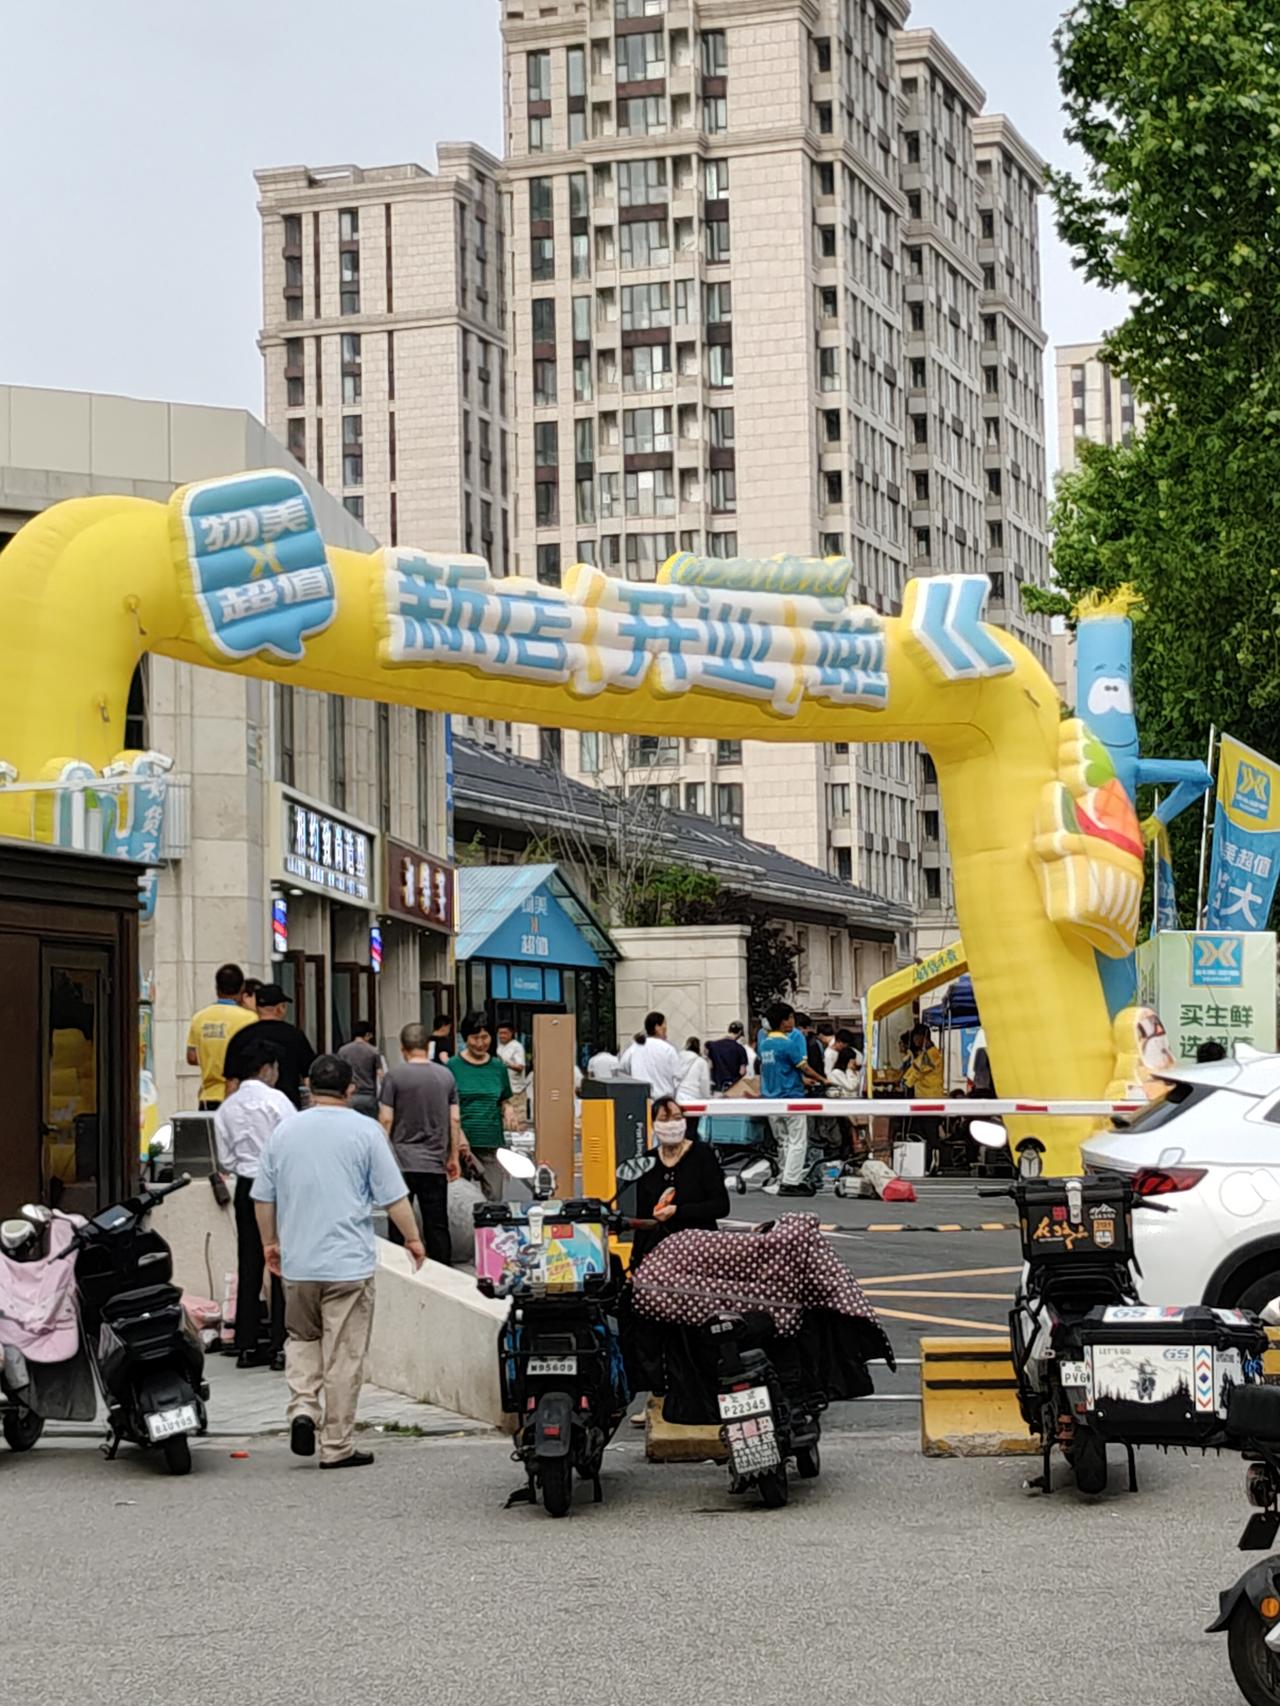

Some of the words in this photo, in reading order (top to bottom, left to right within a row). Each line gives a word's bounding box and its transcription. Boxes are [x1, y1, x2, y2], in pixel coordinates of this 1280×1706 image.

[200, 498, 308, 552] 物美
[215, 567, 331, 624] 超值
[1179, 1003, 1254, 1029] 买生鲜
[1162, 1348, 1190, 1361] GS
